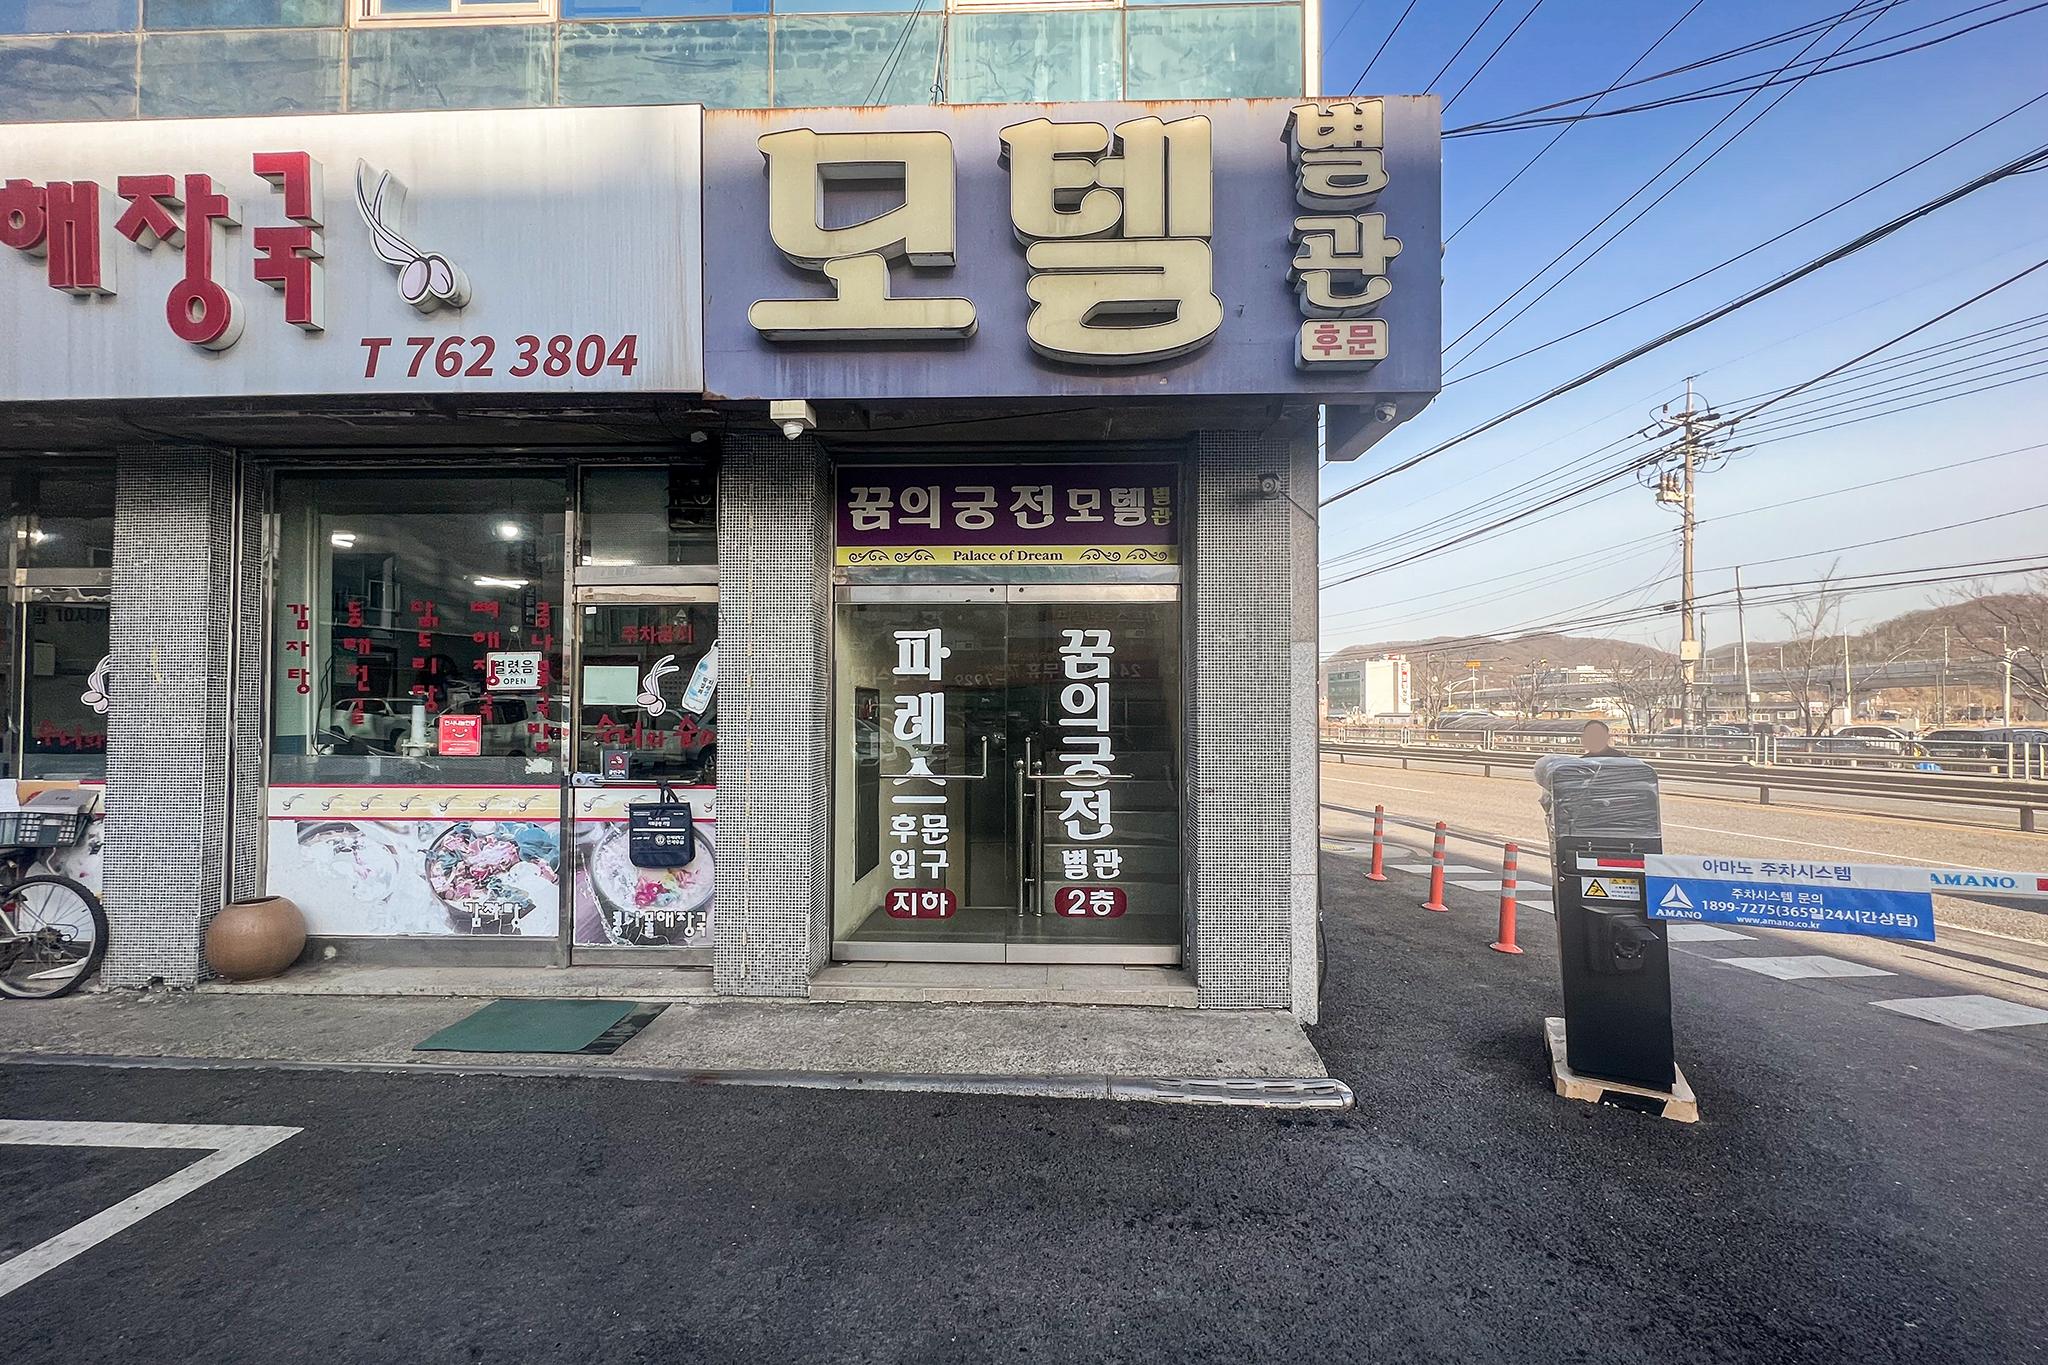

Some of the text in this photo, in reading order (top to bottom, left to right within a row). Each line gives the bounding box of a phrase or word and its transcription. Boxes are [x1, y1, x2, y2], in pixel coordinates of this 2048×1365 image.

[1290, 98, 1403, 310] 별관
[0, 151, 324, 346] 해장국
[748, 114, 1225, 362] 모텔
[1312, 325, 1377, 356] 후문
[360, 334, 640, 378] T 762 3804
[952, 550, 1063, 562] Palace of Dream
[286, 604, 310, 694] 감자탕
[495, 659, 534, 675] 열렸음
[503, 677, 527, 686] OPEN
[1059, 629, 1115, 840] 꿈의궁전
[889, 814, 950, 845] 후문
[890, 850, 950, 880] 입구
[1061, 849, 1123, 880] 별관
[1702, 859, 1851, 881] 아마노 주차시스템
[893, 891, 949, 916] 지하
[1068, 889, 1116, 916] 2층
[1731, 888, 1823, 906] 주차시스템 문의
[1656, 908, 1702, 920] AMANO
[1736, 915, 1820, 930] www.amano.co.kr
